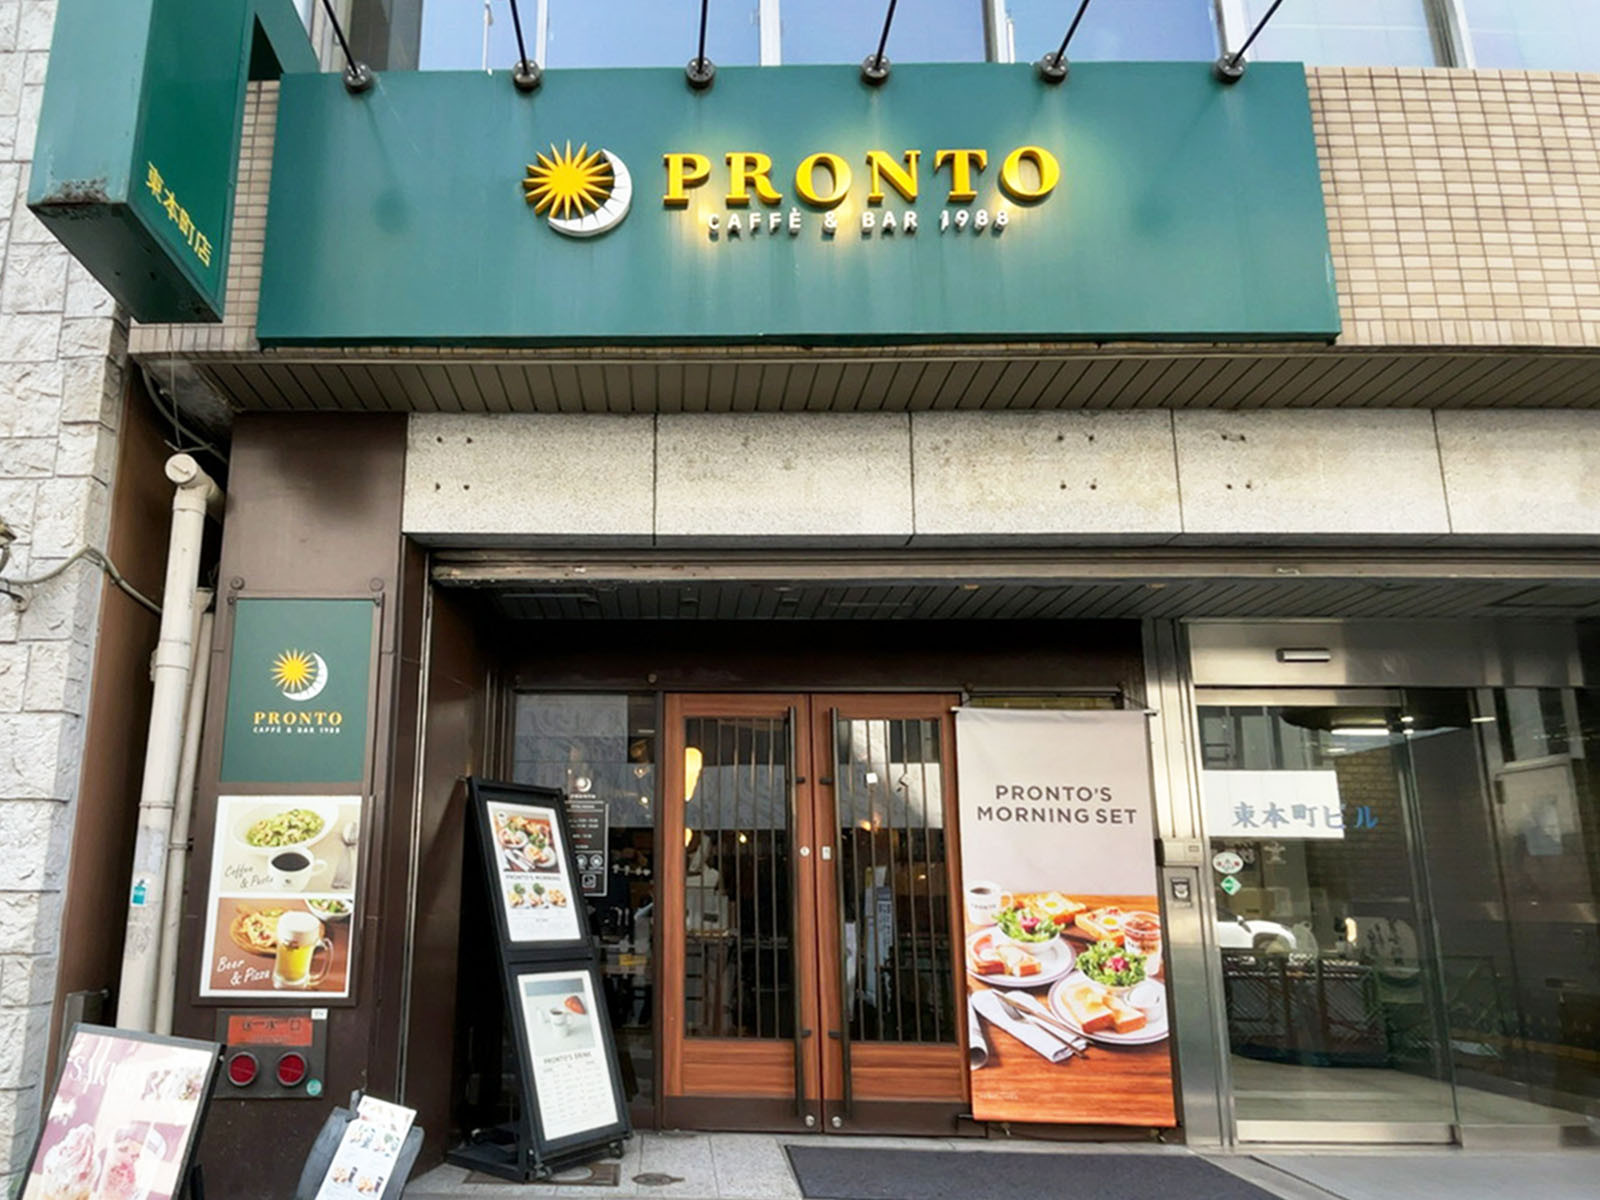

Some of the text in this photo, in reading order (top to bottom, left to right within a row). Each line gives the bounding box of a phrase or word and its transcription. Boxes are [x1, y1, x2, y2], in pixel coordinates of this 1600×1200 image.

[663, 146, 1061, 208] PRONTO
[146, 161, 213, 267] 東本町店
[708, 208, 1010, 234] CAFFÈ & BAR 1988
[253, 711, 343, 726] PRONTO
[995, 785, 1113, 802] PRONTO'S
[977, 806, 1138, 825] MORNING SET
[1231, 801, 1379, 830] 東本町ビル
[216, 956, 245, 973] Beer
[230, 967, 270, 986] & Pizza
